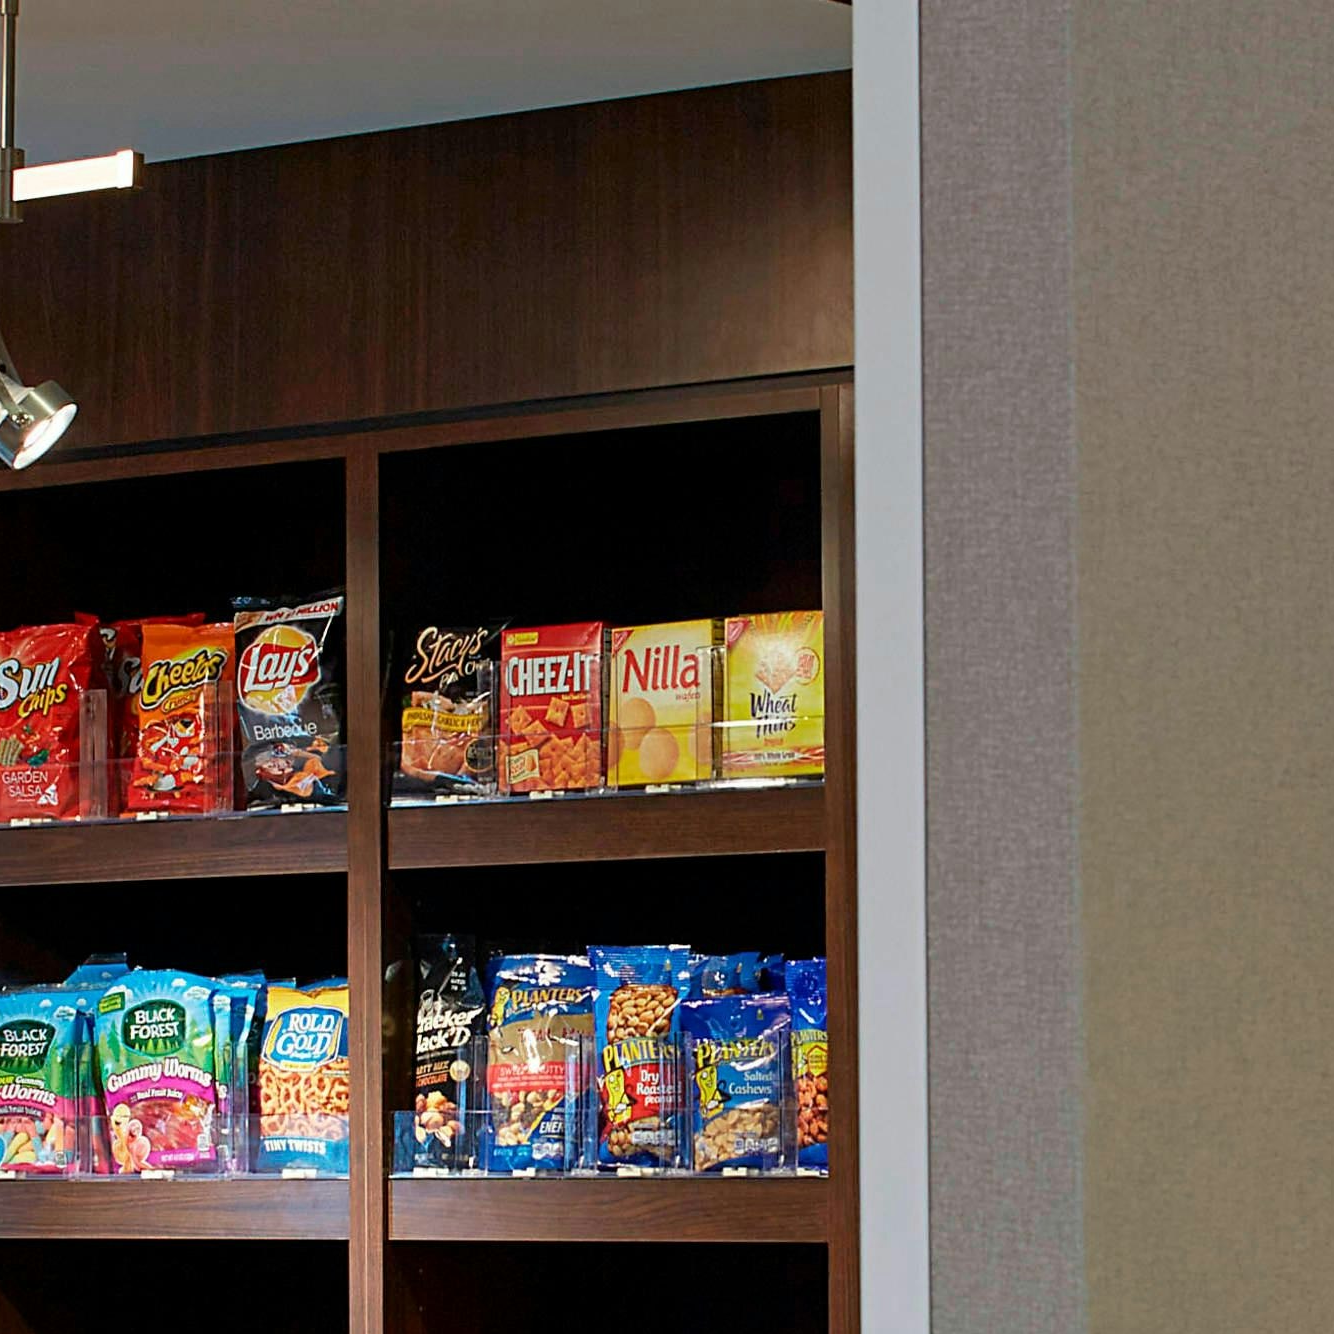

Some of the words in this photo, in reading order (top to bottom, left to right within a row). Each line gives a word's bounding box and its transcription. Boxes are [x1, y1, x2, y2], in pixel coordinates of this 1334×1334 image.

[404, 625, 489, 684] Stacy's
[142, 651, 225, 706] Cheetos
[243, 645, 314, 693] Lay's
[621, 644, 701, 694] Nilla
[17, 683, 68, 719] Chips
[749, 690, 799, 718] Wheat
[1, 769, 49, 785] GARDEN
[8, 784, 43, 798] SALSA
[511, 987, 584, 1011] PLANTERS
[133, 1007, 177, 1025] BLACK
[288, 1013, 335, 1034] ROLD
[2, 1028, 48, 1043] BLACK
[130, 1021, 180, 1041] FOREST
[0, 1041, 48, 1058] FOREST
[275, 1032, 332, 1057] GOLD
[107, 1062, 162, 1093] Gummy
[164, 1057, 213, 1088] Worms
[640, 1069, 660, 1087] Dry
[743, 1070, 774, 1082] Salted
[728, 1082, 773, 1095] Cashews
[264, 1138, 287, 1153] TINY
[288, 1139, 327, 1155] TWISTS
